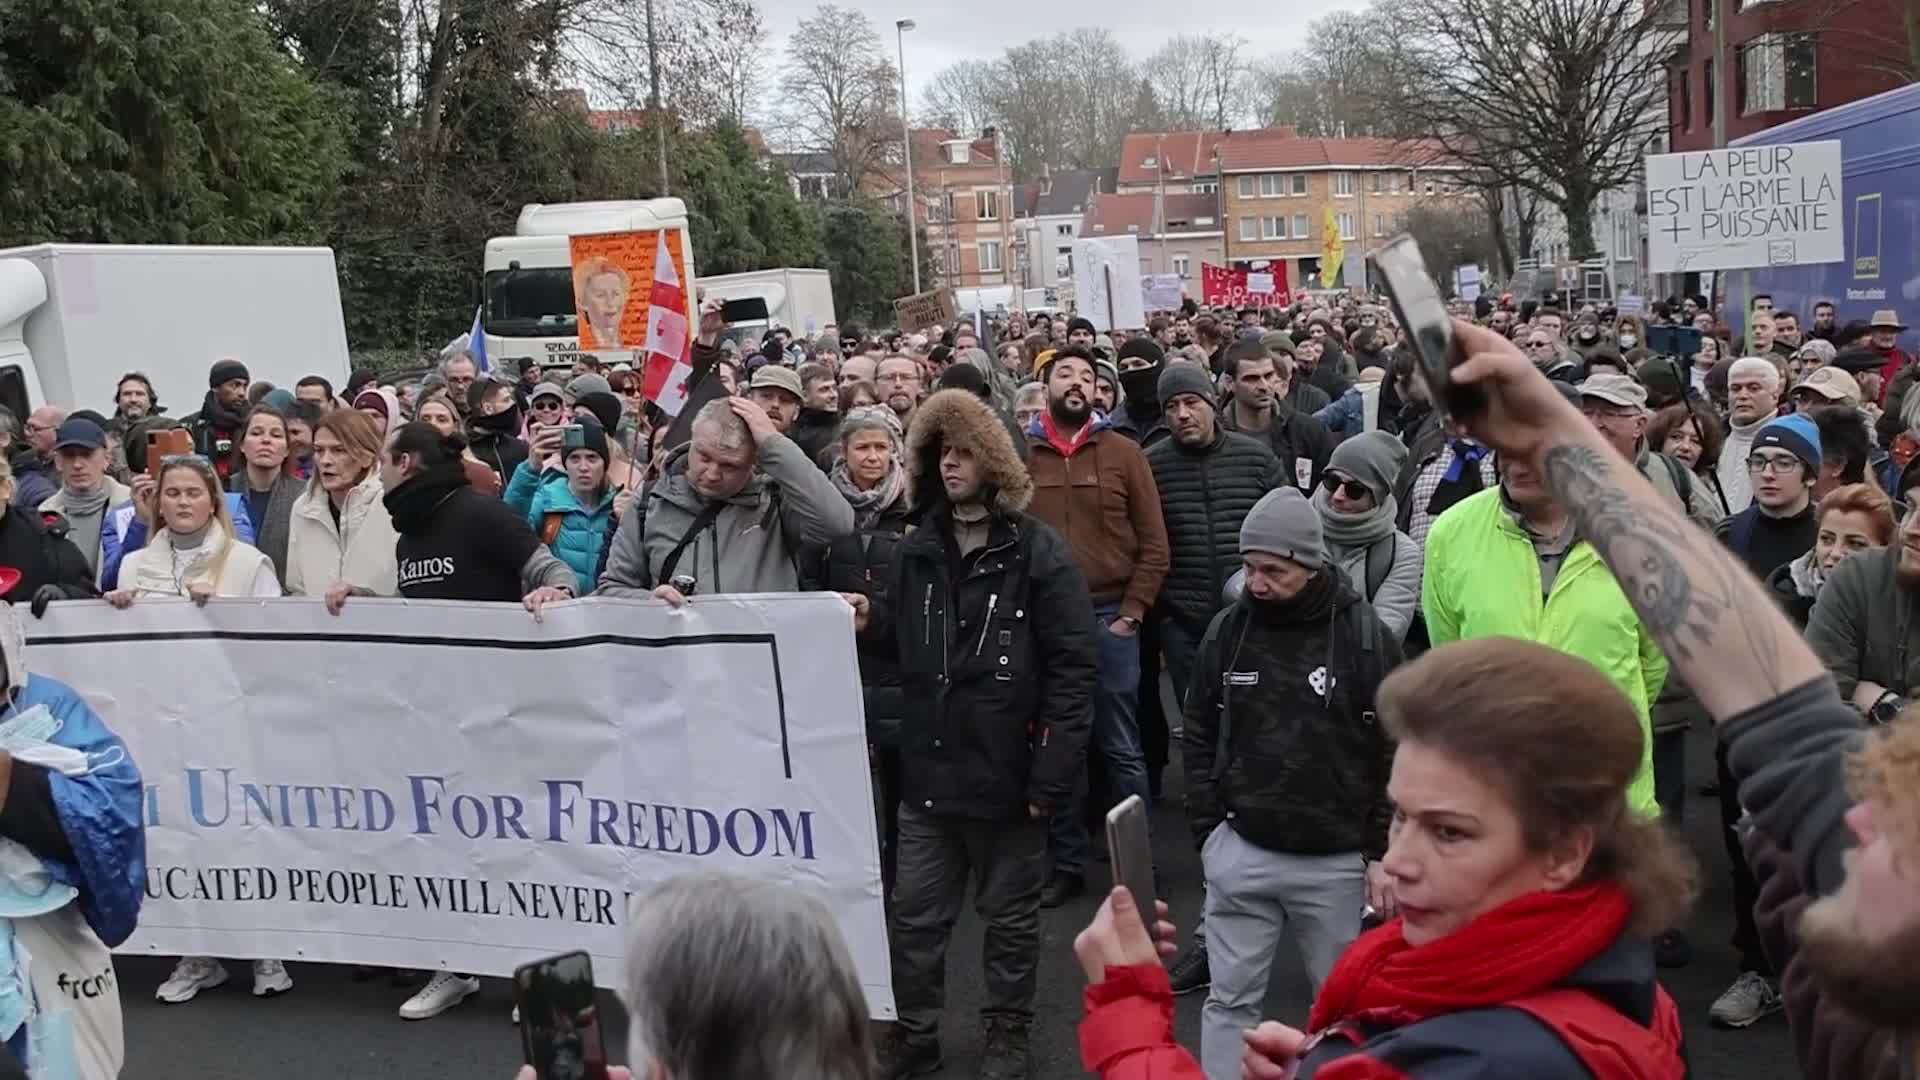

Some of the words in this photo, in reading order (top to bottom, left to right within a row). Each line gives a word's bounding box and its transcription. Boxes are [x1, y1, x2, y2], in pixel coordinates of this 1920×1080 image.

[1682, 153, 1718, 181] LA
[1727, 146, 1793, 177] PEUR
[1650, 186, 1694, 217] EST
[1702, 177, 1791, 212] L'ARME
[1801, 173, 1837, 203] LA
[184, 767, 396, 833] UNITED
[405, 774, 536, 841] FOR
[539, 779, 817, 860] FREEDOM
[144, 866, 278, 902] UCATED
[286, 869, 409, 909] PEOPLE
[413, 875, 502, 916] WILL
[505, 880, 617, 926] NEVER
